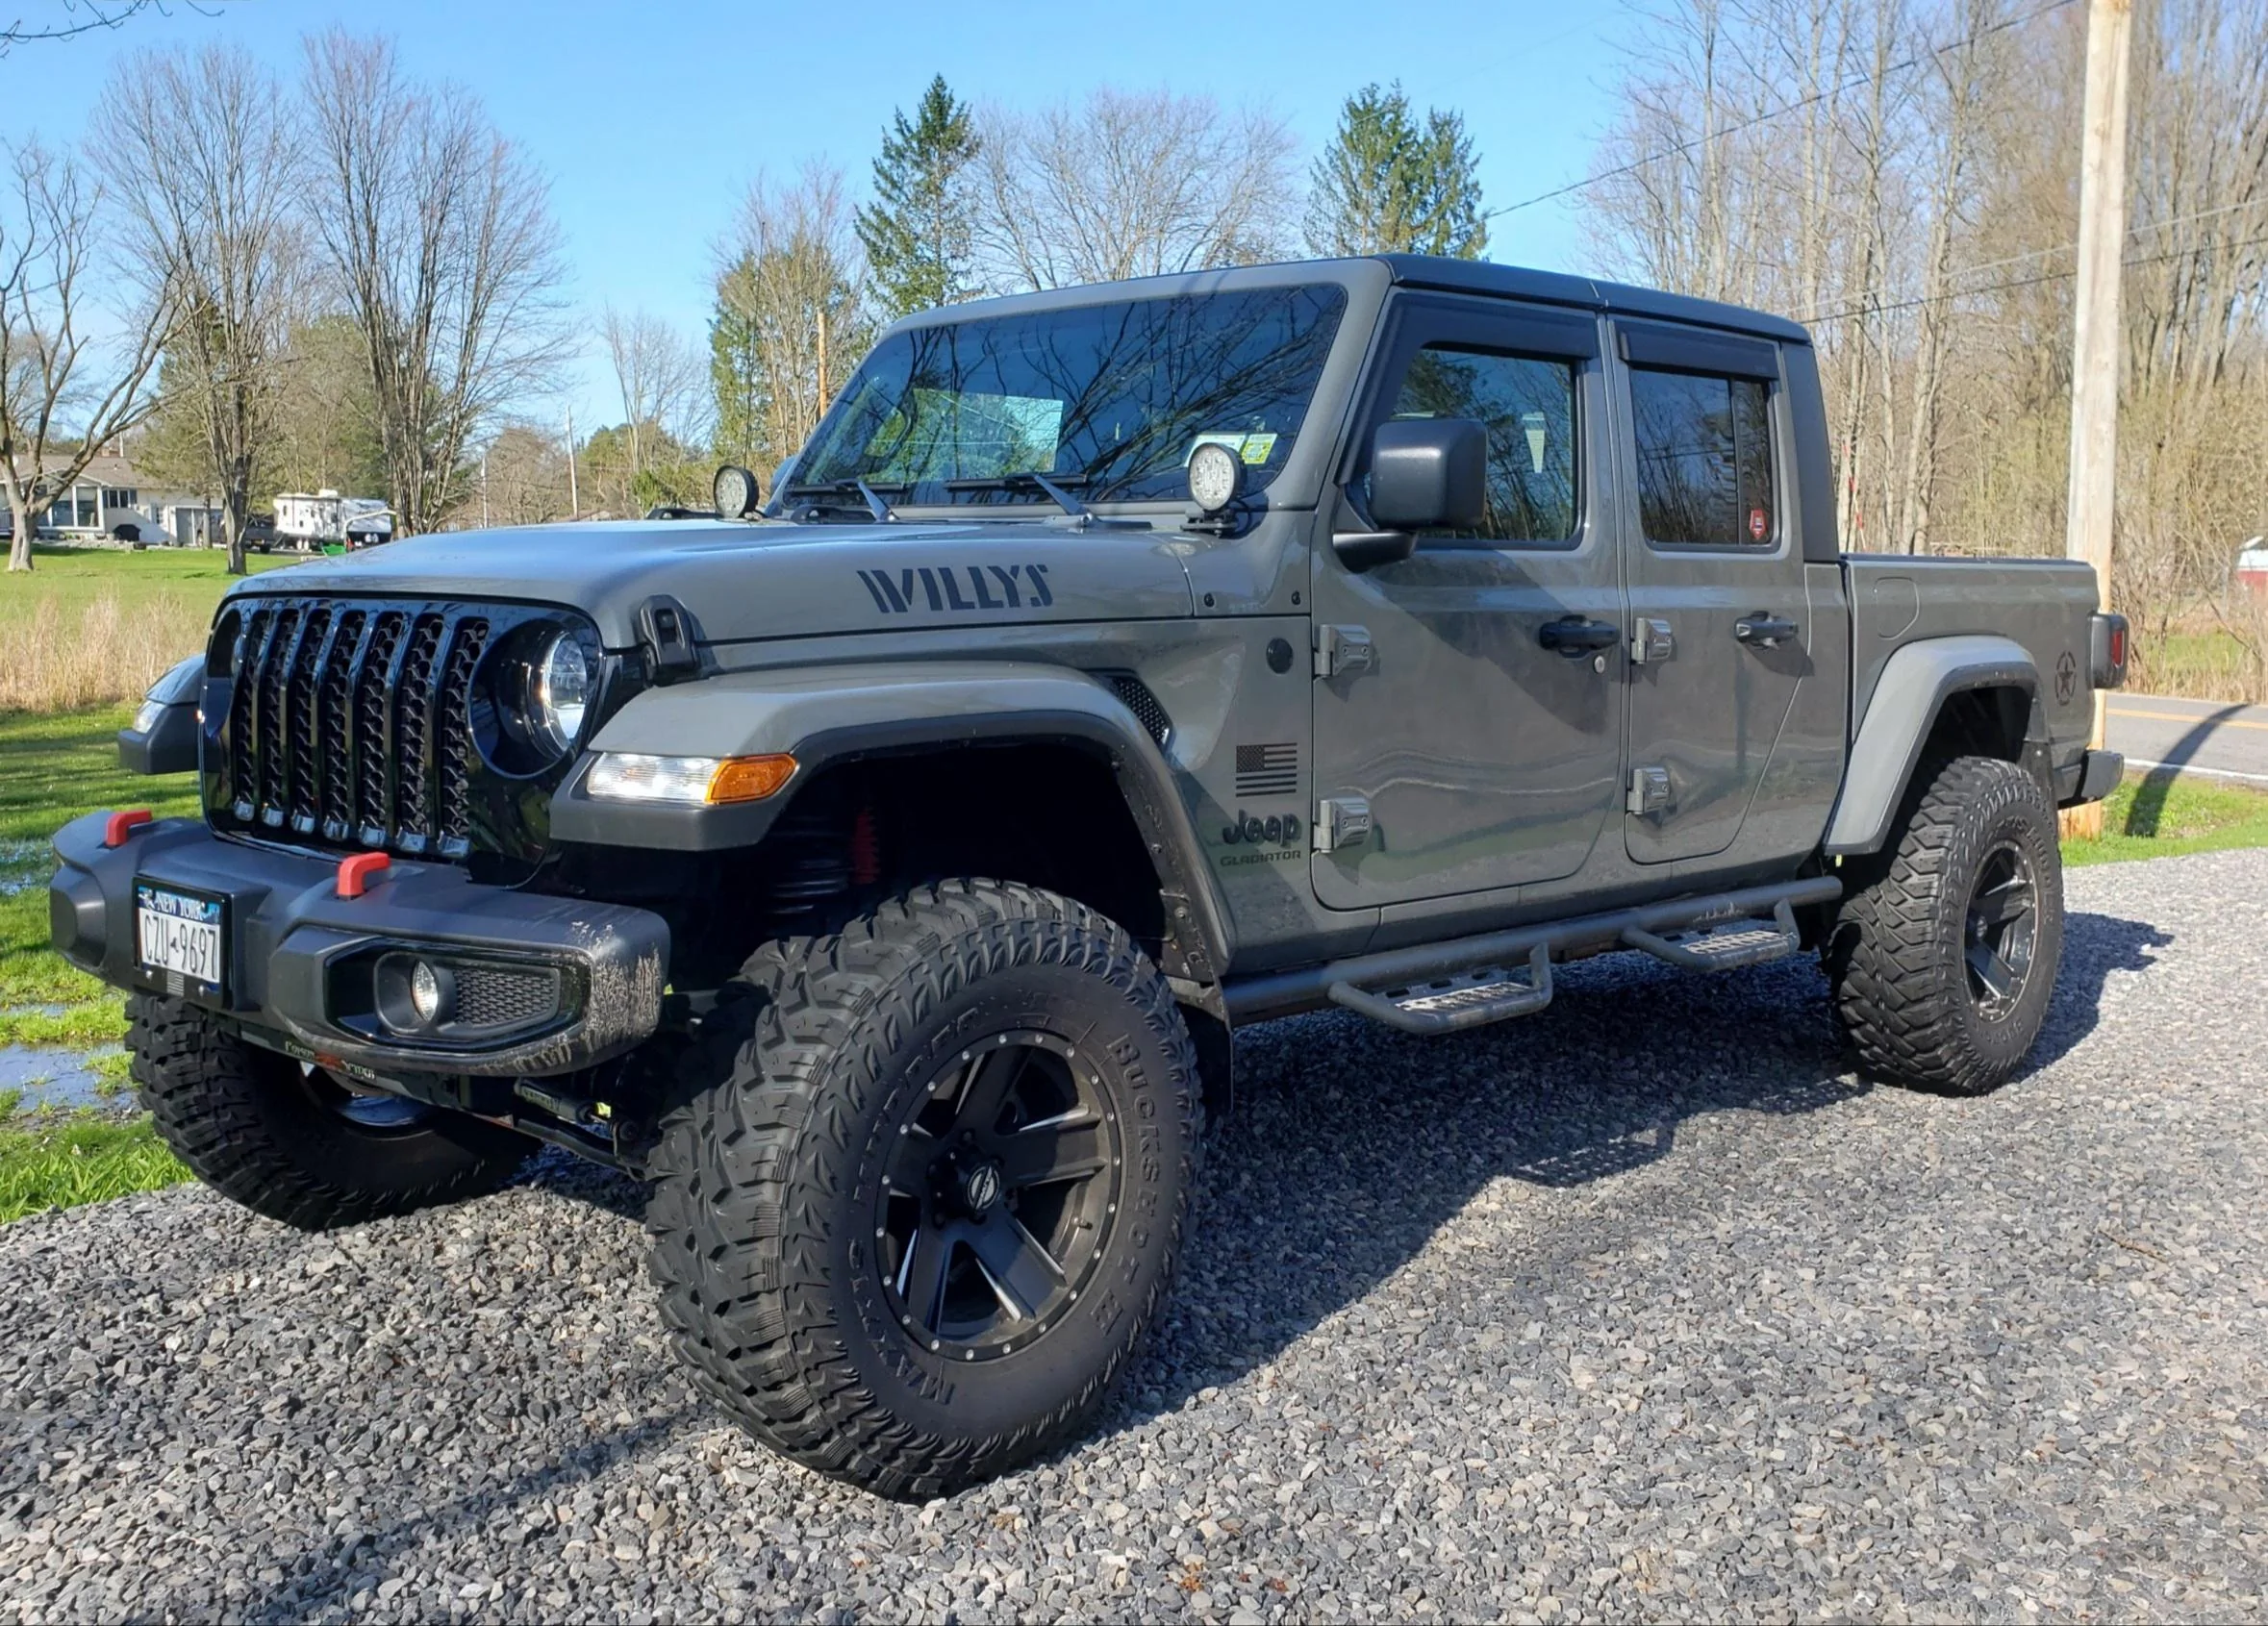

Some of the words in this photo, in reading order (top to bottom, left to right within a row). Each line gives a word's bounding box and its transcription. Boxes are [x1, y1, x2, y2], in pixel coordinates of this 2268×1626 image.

[856, 563, 1053, 613] WILLYS
[1222, 809, 1303, 848] Jeep
[1220, 849, 1301, 867] GLADIATOR
[155, 890, 177, 914] NEW
[178, 896, 205, 921] YORK
[179, 922, 216, 979] 9697
